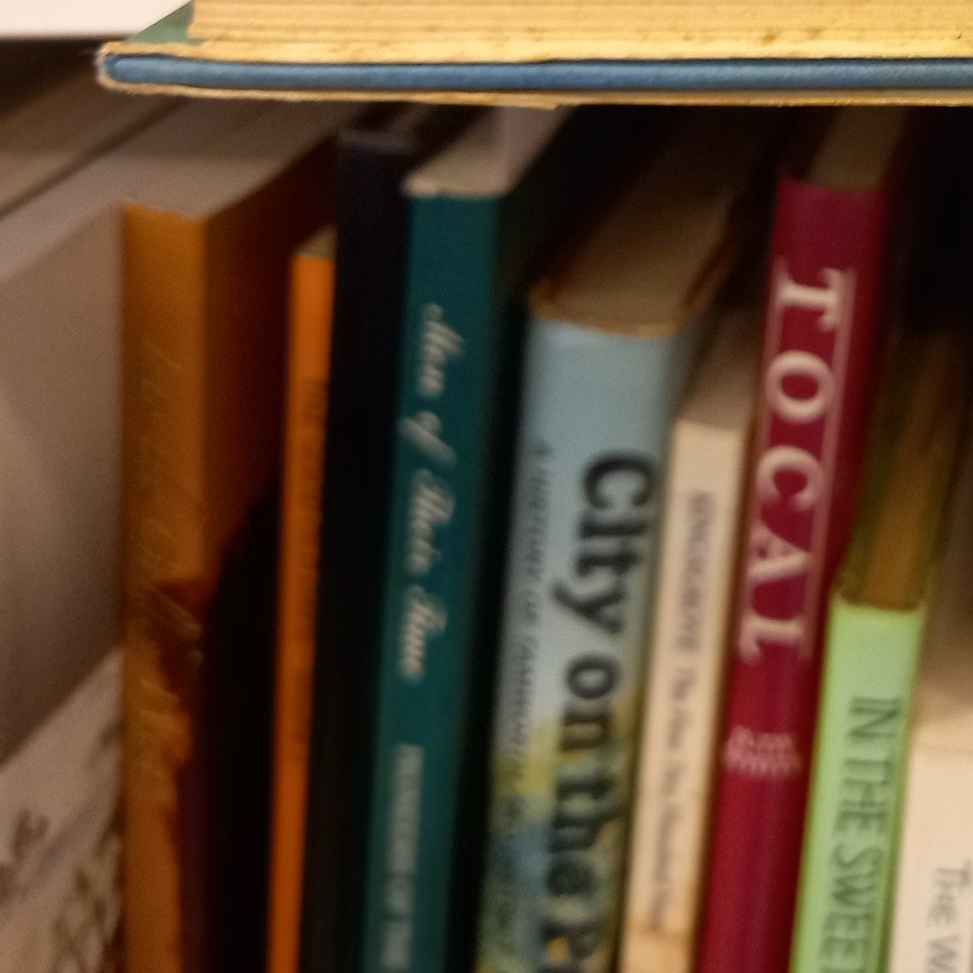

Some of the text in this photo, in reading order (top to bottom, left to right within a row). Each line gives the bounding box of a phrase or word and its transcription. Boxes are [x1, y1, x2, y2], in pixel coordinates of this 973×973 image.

[397, 409, 458, 468] of
[737, 260, 853, 663] TOCAL
[557, 653, 621, 753] on
[849, 693, 900, 740] IN
[546, 760, 611, 902] the
[835, 752, 894, 845] THE
[541, 910, 603, 973] P
[922, 861, 972, 973] THE W
